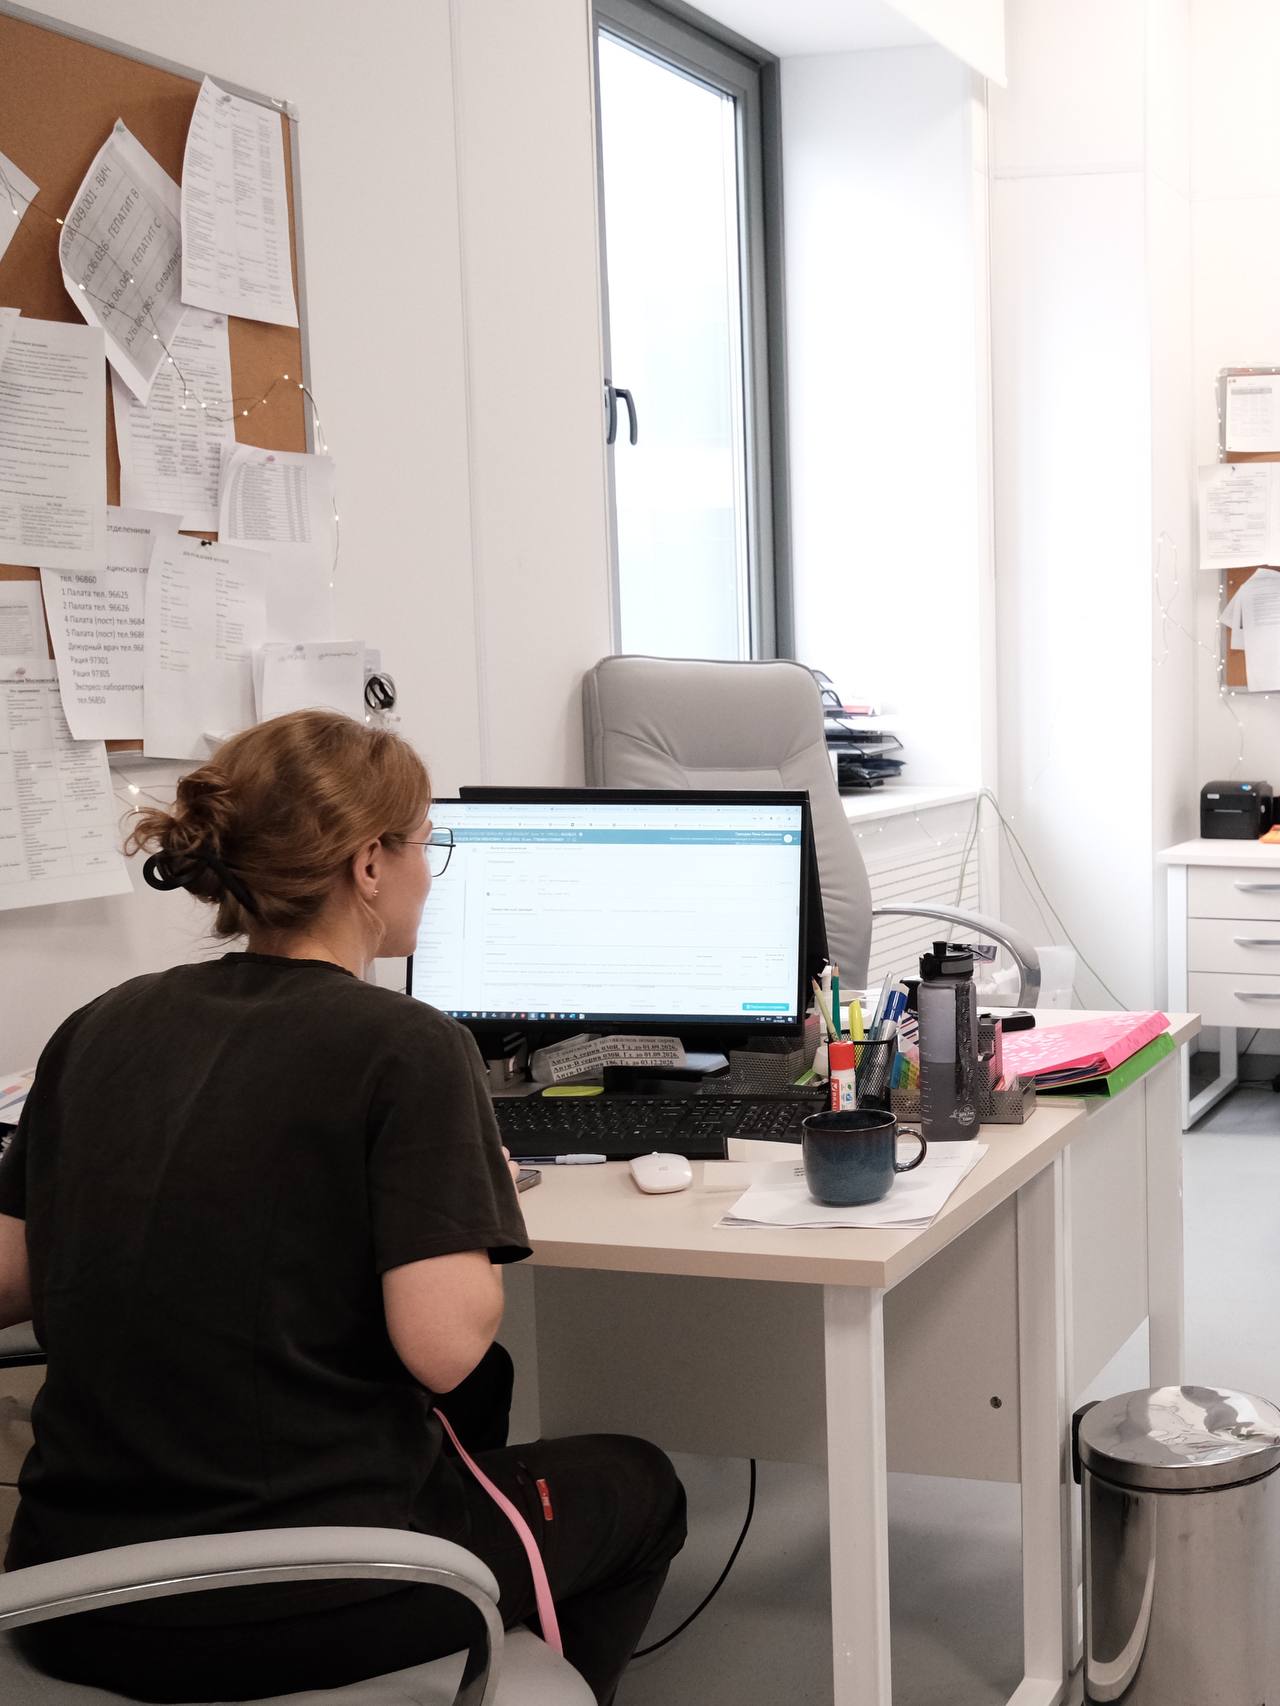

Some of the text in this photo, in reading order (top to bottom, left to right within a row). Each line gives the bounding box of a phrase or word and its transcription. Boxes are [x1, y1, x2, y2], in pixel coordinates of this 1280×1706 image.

[95, 167, 112, 188] ВИЧ
[108, 197, 135, 242] ГЕПАТИТ
[131, 224, 156, 267] ГЕПАТИТ
[67, 588, 91, 597] Палата
[68, 601, 92, 610] Палата
[70, 615, 93, 624] Палата
[71, 629, 94, 638] Палата
